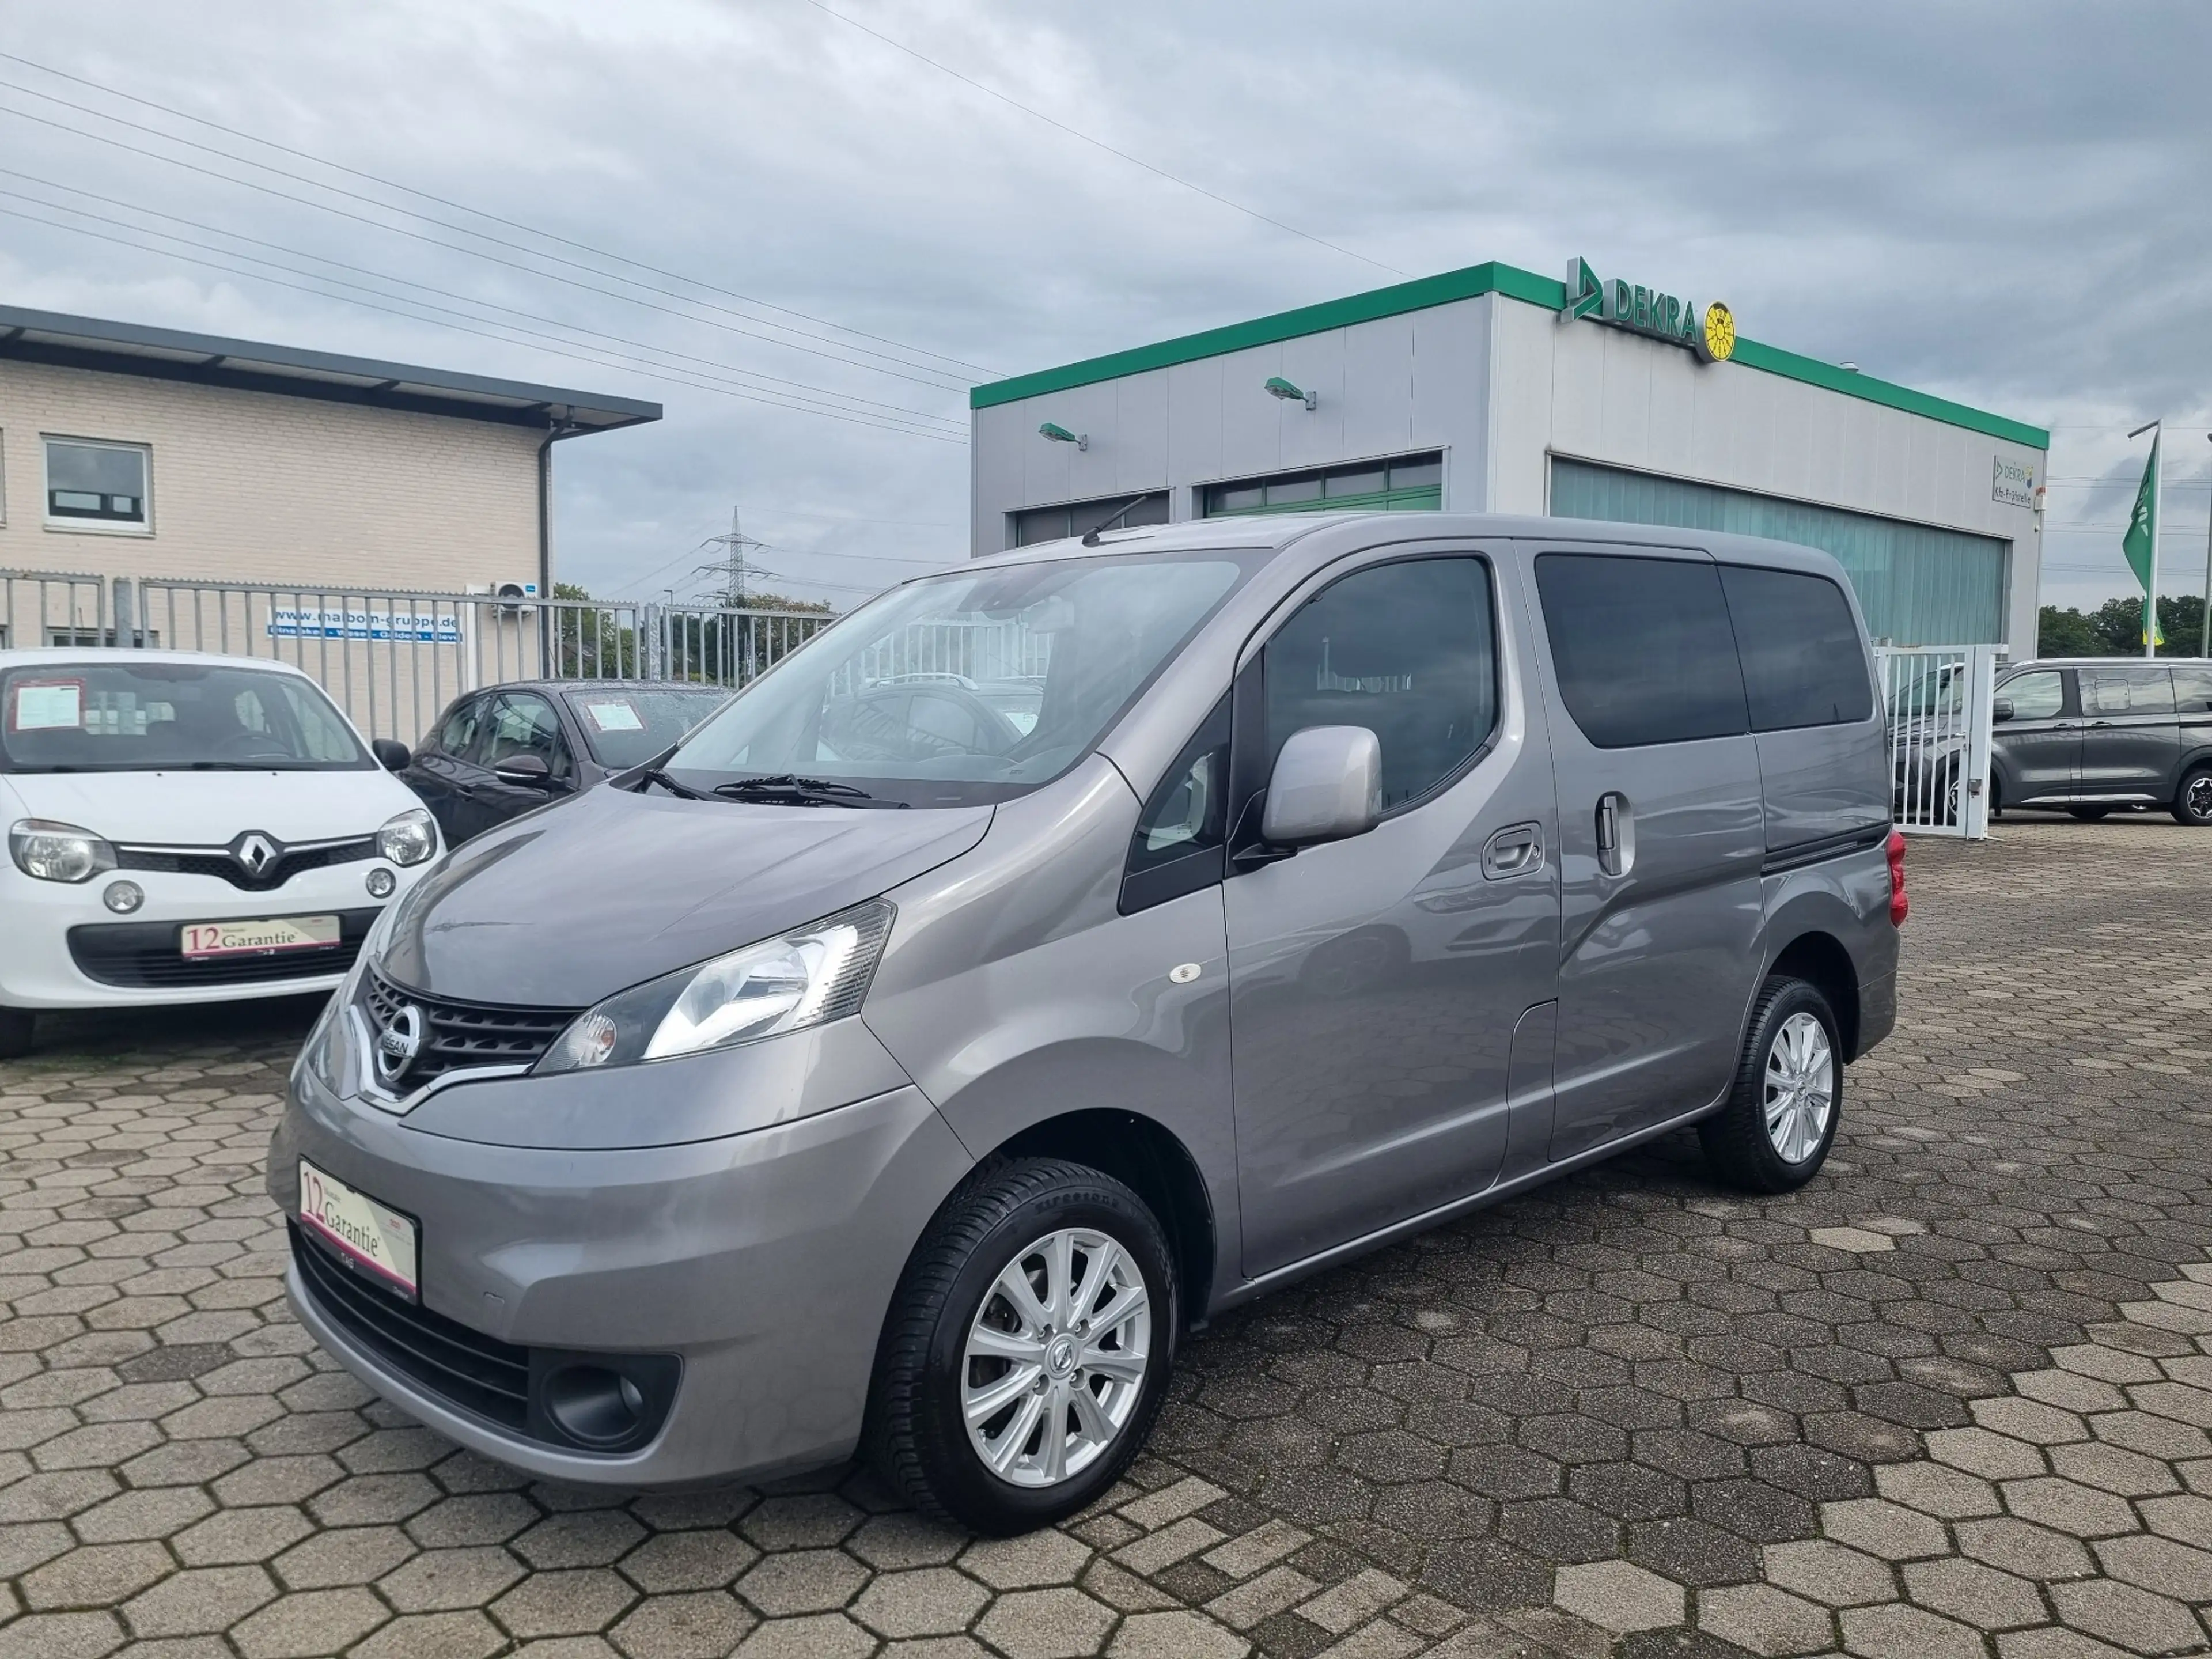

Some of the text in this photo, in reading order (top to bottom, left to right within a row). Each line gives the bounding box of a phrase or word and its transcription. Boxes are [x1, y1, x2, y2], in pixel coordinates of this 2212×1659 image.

[1615, 278, 1699, 344] DEKRA
[274, 611, 460, 628] www.mabom-gruppe.de
[187, 926, 220, 950] 12
[222, 931, 295, 948] Garantie
[304, 1171, 325, 1224] 12
[325, 1200, 378, 1257] Garantie
